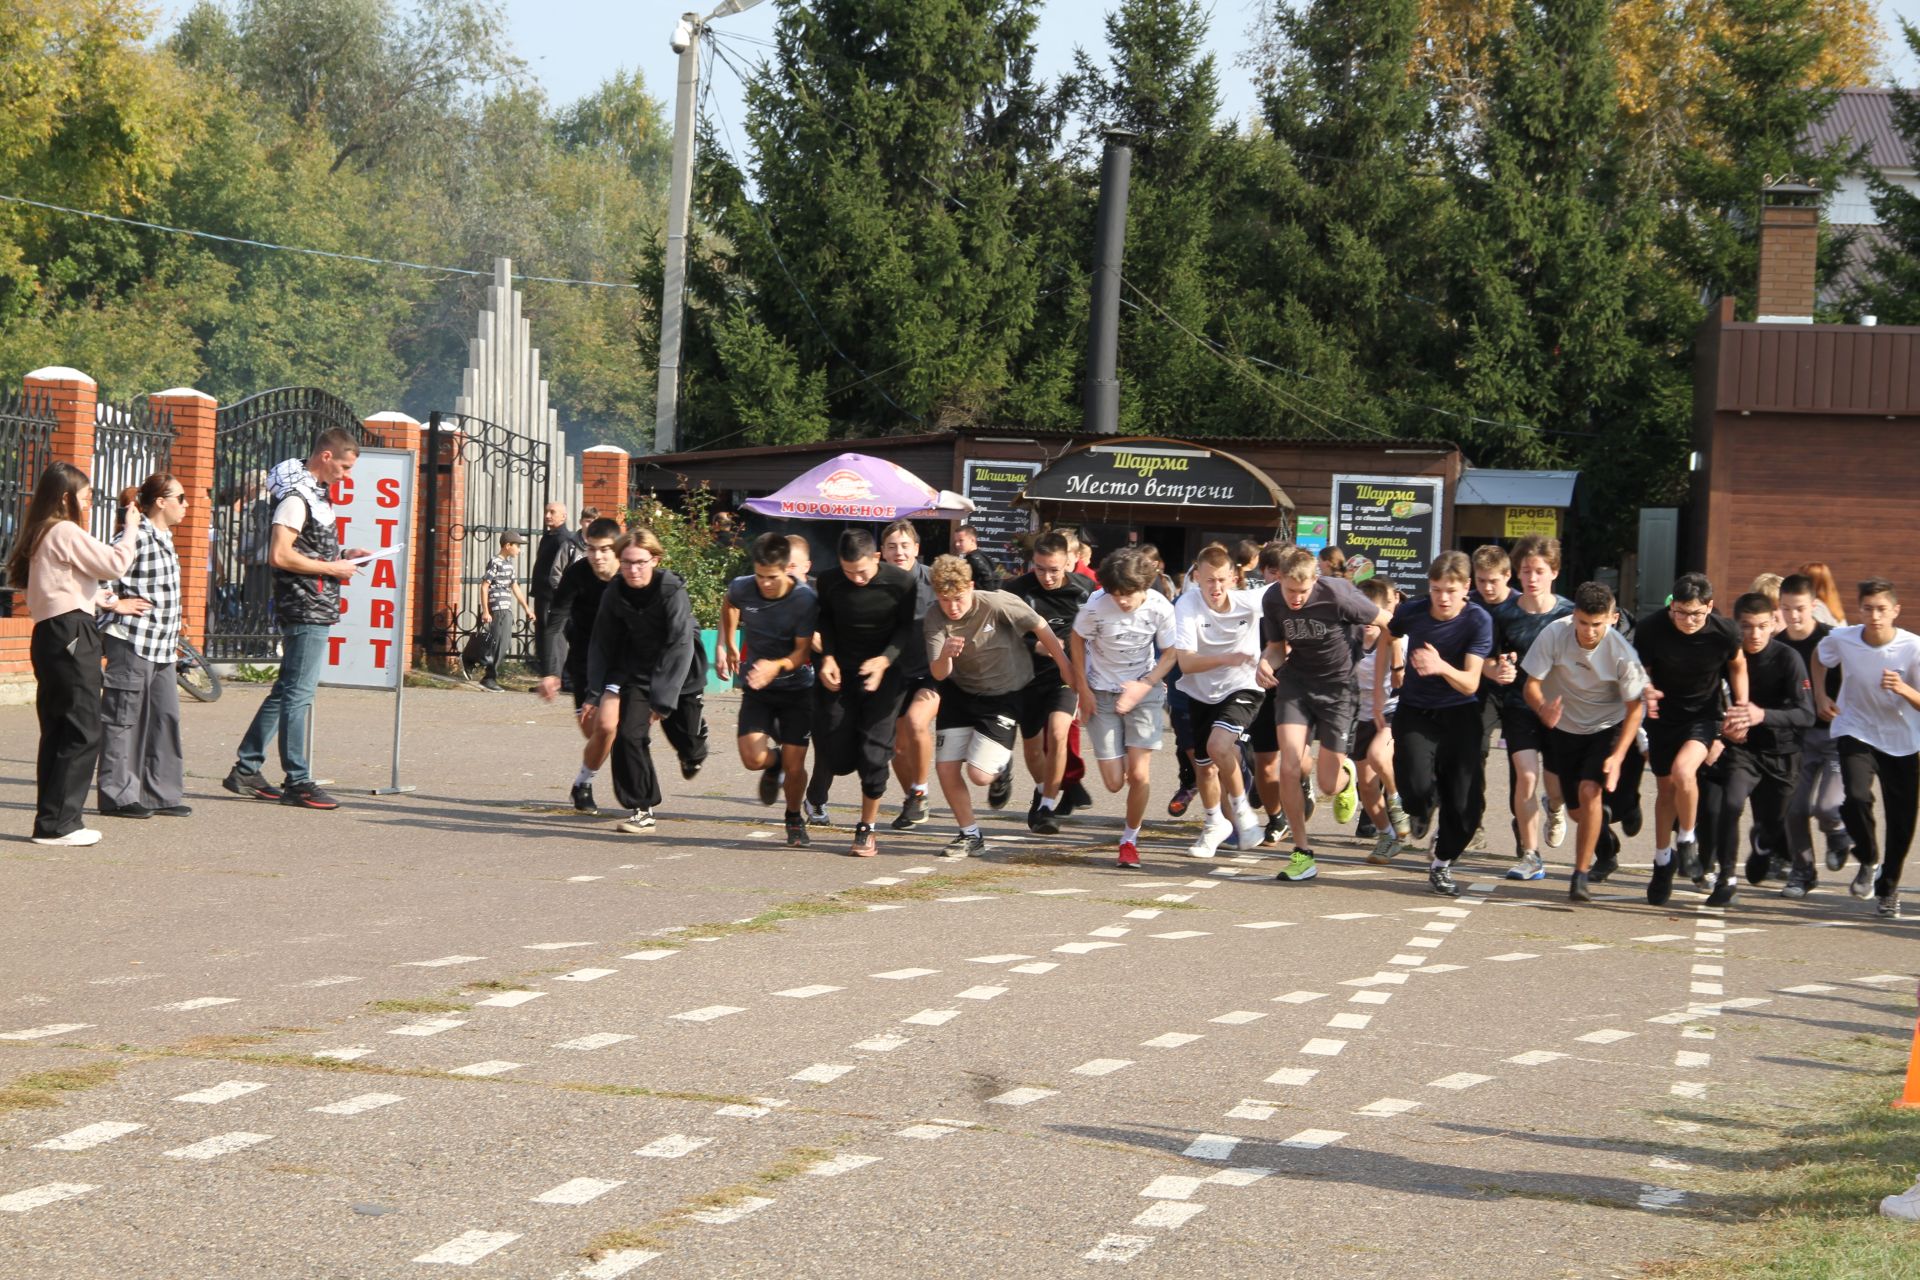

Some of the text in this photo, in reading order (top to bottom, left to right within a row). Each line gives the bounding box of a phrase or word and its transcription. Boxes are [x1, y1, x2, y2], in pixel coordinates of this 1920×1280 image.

[1113, 453, 1189, 477] Шаурма
[975, 468, 1027, 483] Шашлык
[1066, 474, 1235, 504] Место встречи
[1356, 485, 1416, 505] Шаурма
[780, 501, 897, 518] МОРОЖЕНОЕ
[1508, 508, 1554, 519] ДРОВА
[1346, 533, 1407, 550] Закрытая
[1379, 548, 1418, 560] пицца
[369, 478, 400, 669] START
